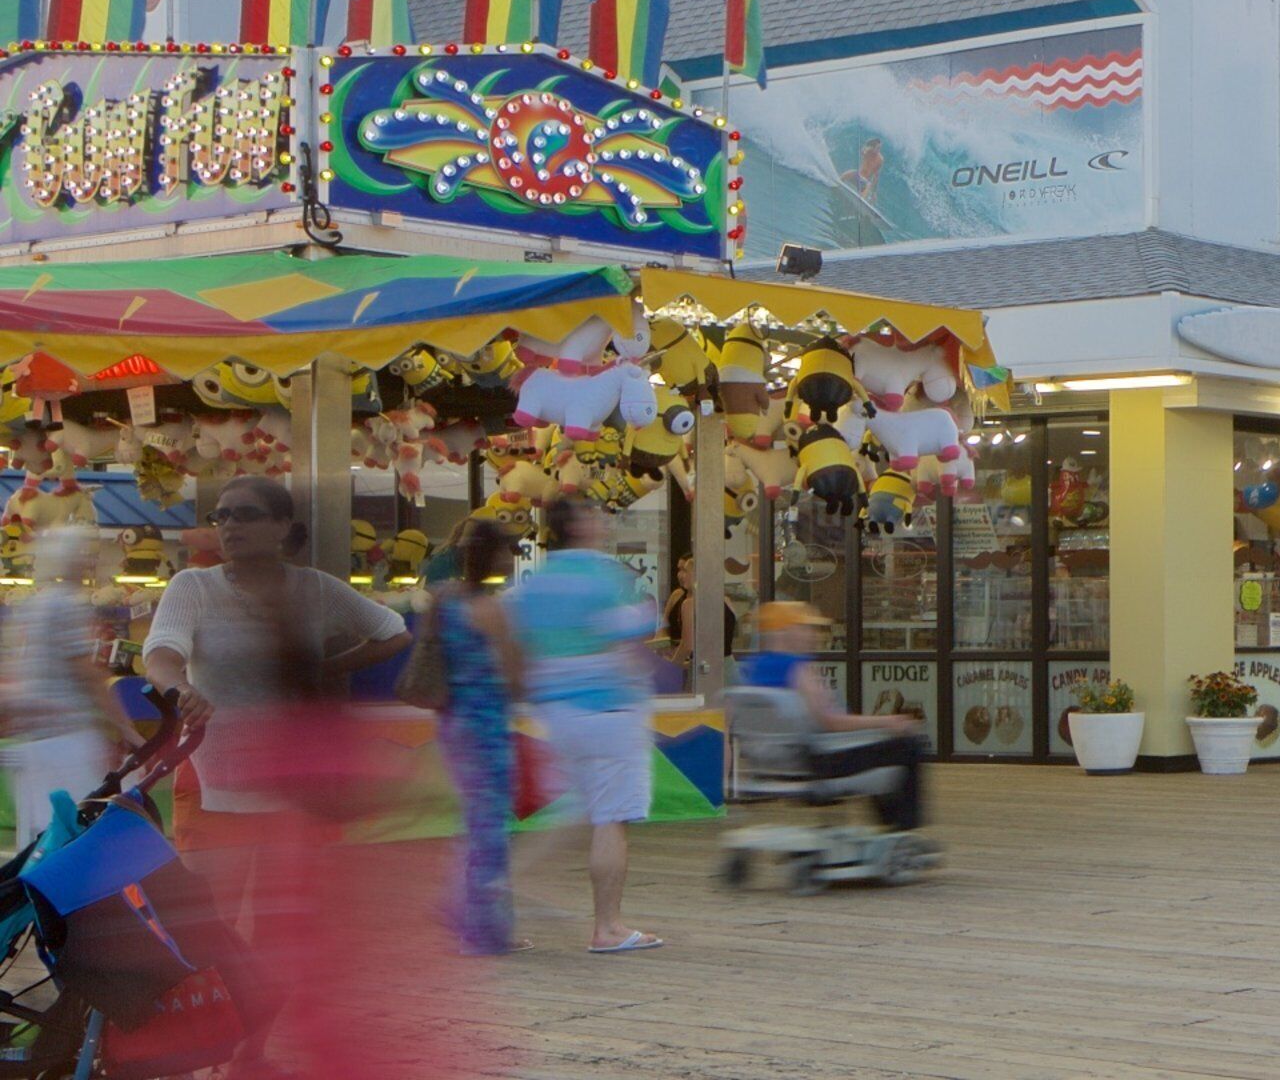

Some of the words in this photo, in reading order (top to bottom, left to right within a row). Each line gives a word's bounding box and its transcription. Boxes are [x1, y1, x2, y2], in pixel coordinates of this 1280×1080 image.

[952, 156, 1068, 188] O'NEILL
[871, 664, 929, 682] FUDGE
[957, 669, 995, 689] CARAMEL
[998, 669, 1030, 690] APPLES
[1052, 667, 1088, 690] CANDY
